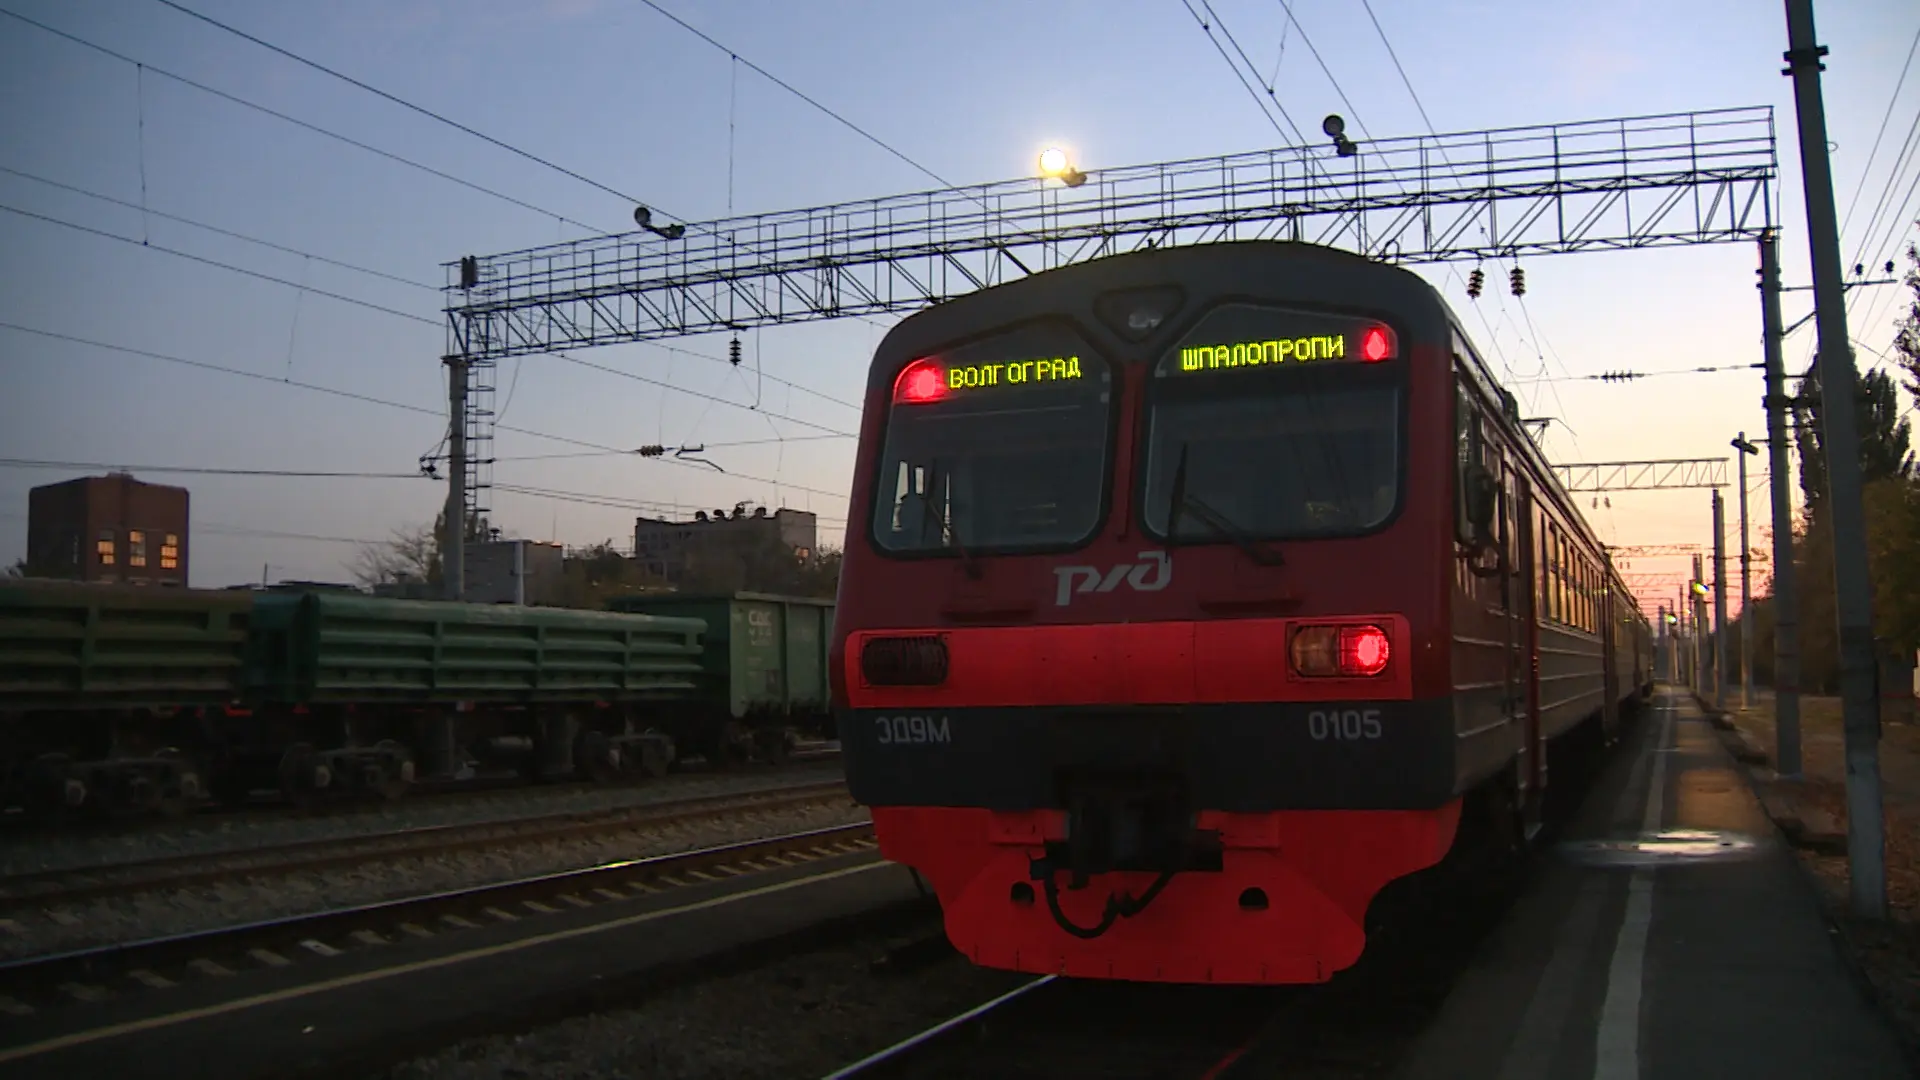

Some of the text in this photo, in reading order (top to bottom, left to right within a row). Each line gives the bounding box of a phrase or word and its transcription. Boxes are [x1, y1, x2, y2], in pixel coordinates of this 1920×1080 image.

[1183, 335, 1344, 371] ШПАЛОПРОПИ
[950, 356, 1081, 388] ВОЛГОГРАД
[1308, 709, 1382, 740] 0105
